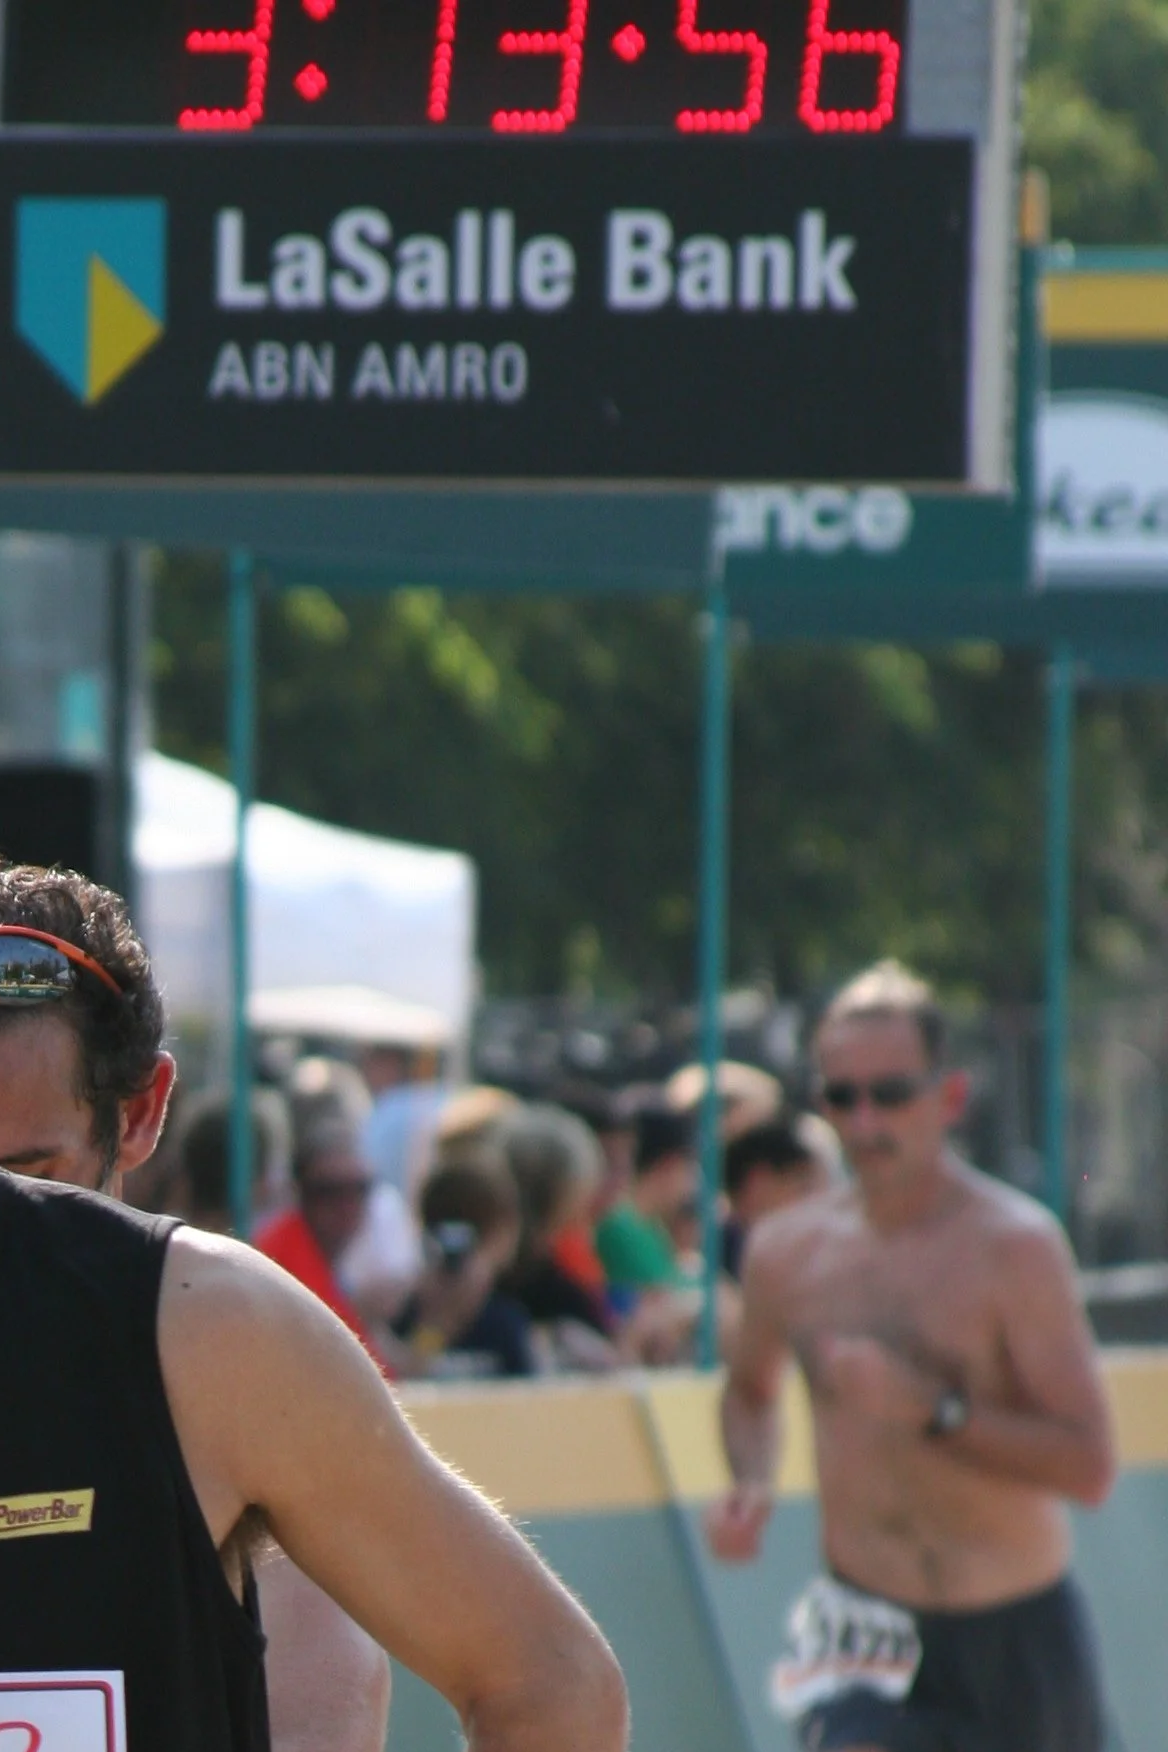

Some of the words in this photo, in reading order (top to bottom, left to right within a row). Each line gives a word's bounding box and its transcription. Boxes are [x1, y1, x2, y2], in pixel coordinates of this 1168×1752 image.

[215, 208, 575, 311] LaSalle
[607, 209, 855, 311] Bank
[210, 344, 332, 398] ABN
[351, 344, 527, 398] AMRO
